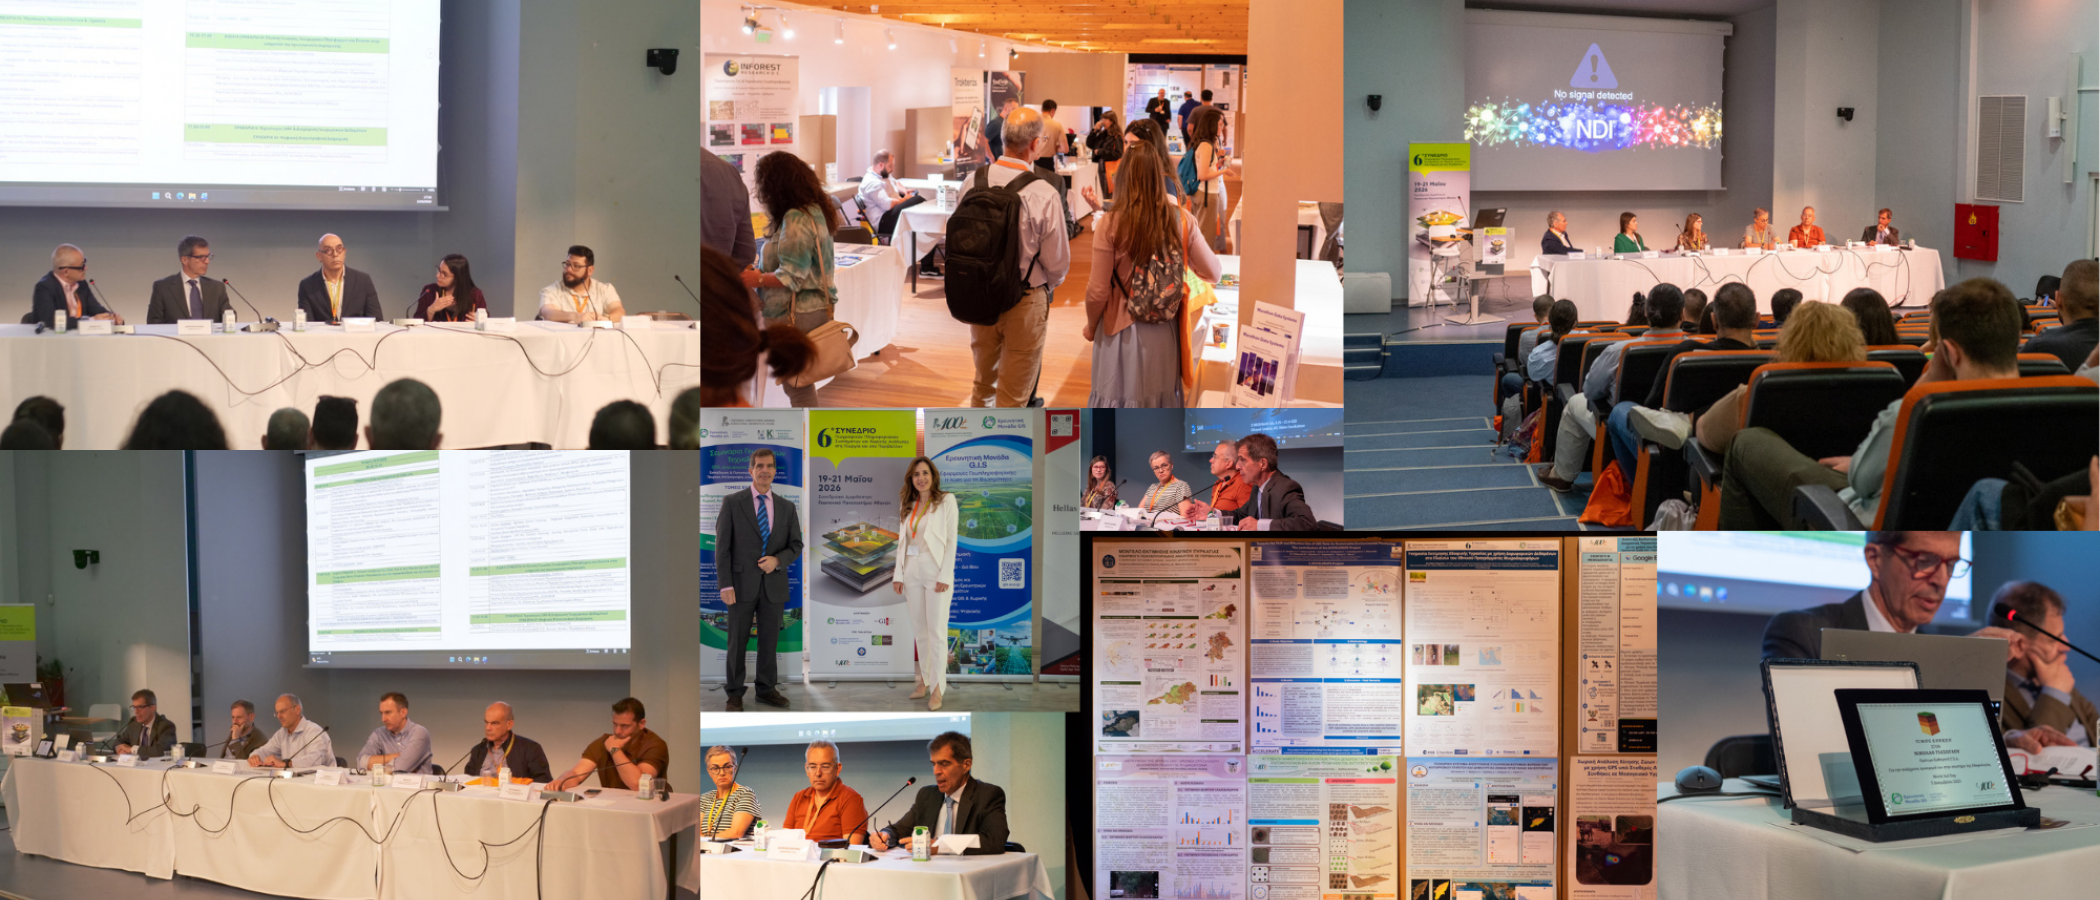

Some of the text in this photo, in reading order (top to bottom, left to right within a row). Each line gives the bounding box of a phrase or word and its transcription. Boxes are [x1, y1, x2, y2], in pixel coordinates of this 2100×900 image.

[1554, 89, 1634, 100] No signal detected
[1576, 119, 1614, 139] NDI
[710, 448, 743, 456] Σεμινάρια
